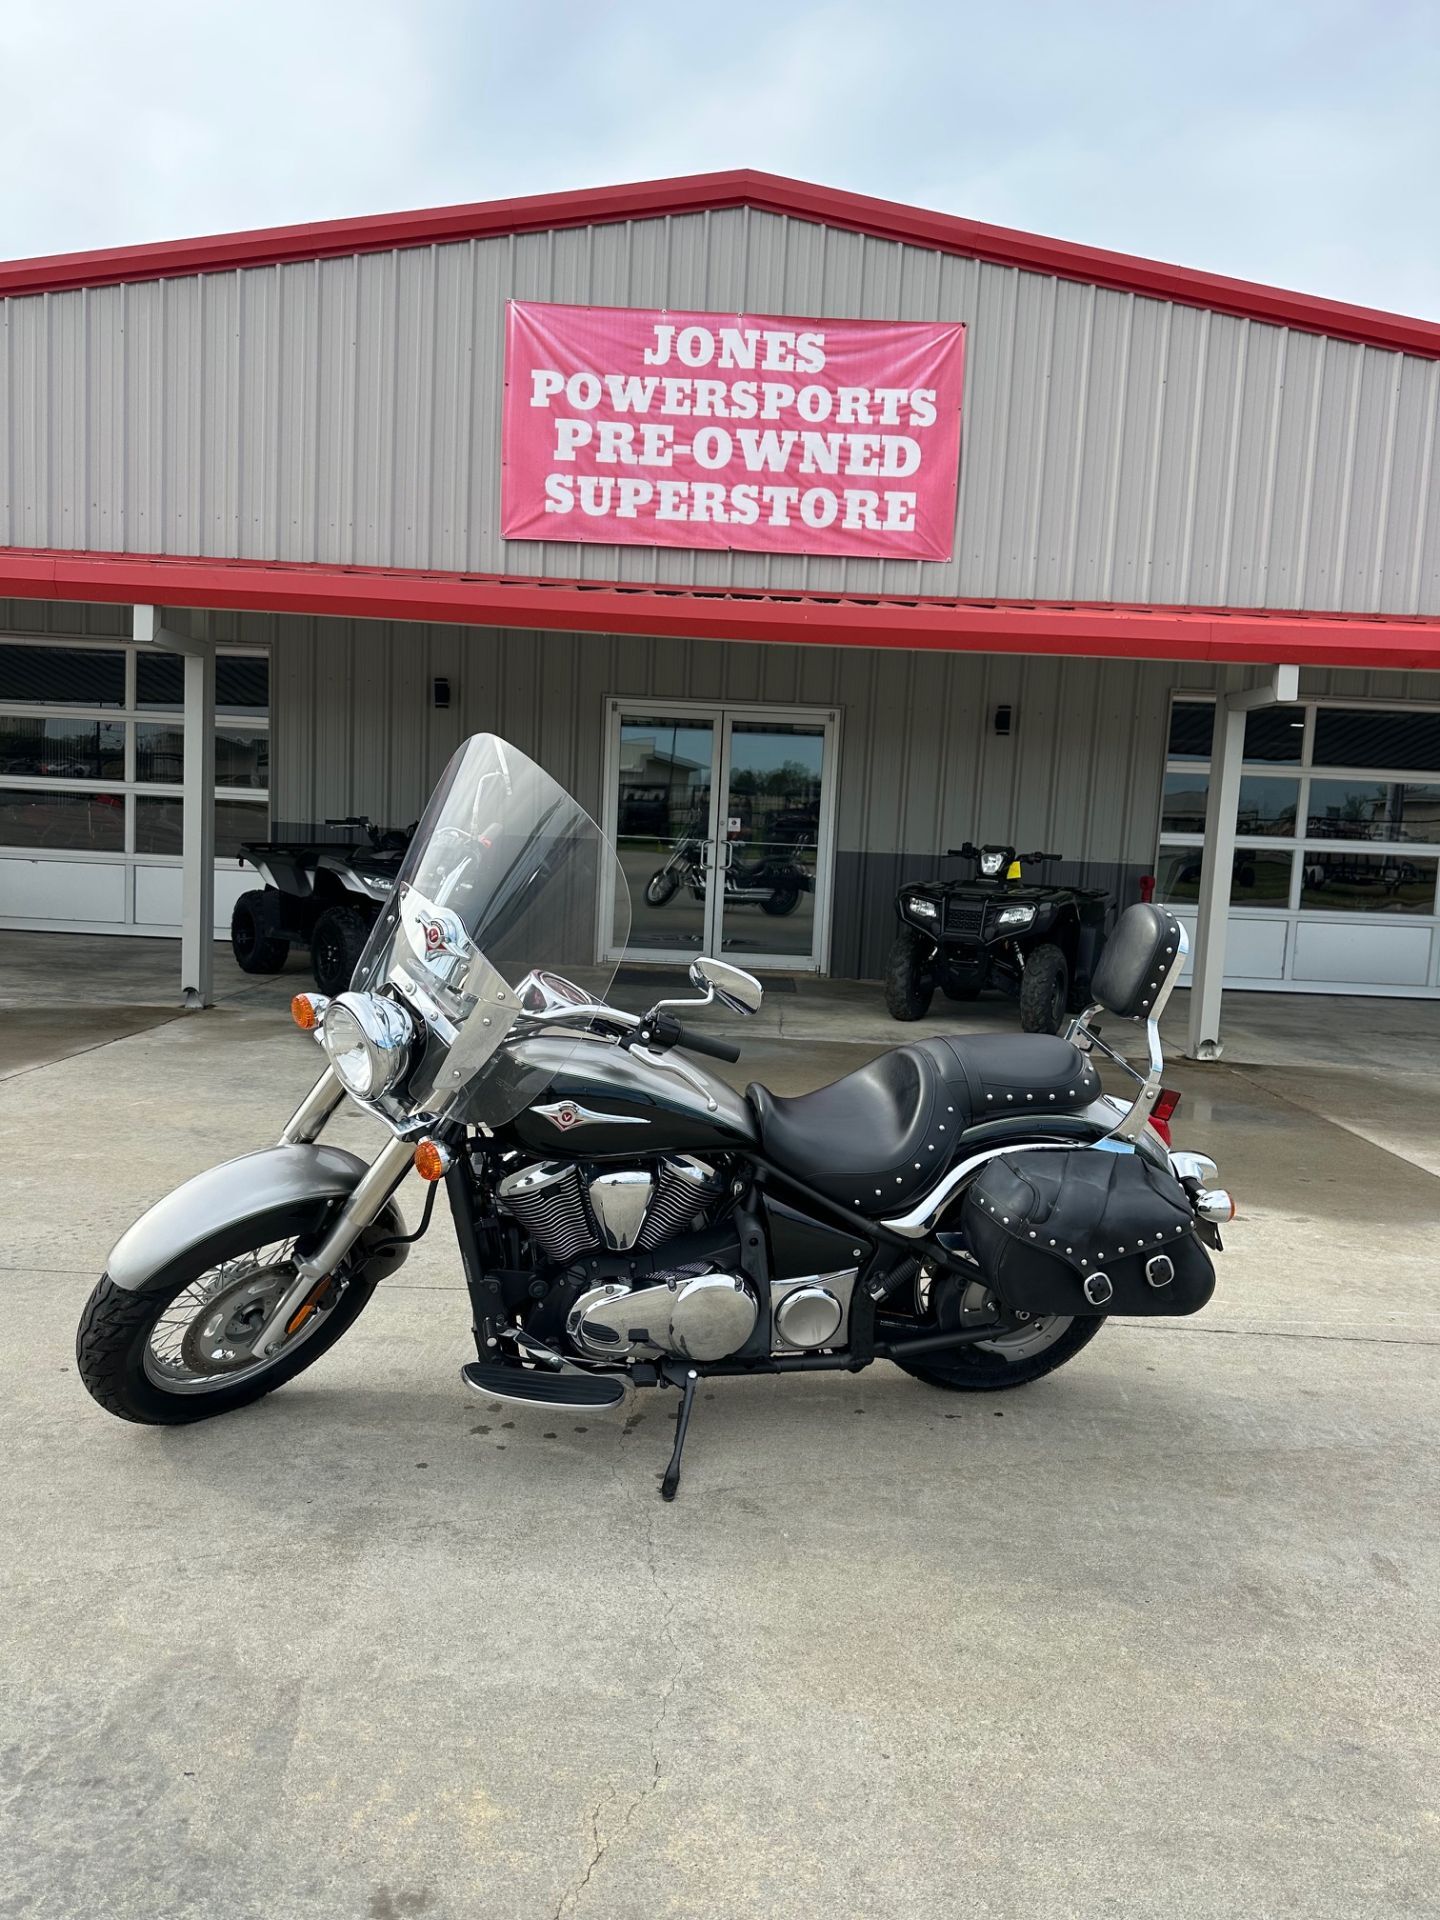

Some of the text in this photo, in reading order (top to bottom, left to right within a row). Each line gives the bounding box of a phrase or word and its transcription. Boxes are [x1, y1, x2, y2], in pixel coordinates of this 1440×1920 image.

[643, 324, 827, 374] JONES
[530, 369, 937, 427] POWERSPORTS
[553, 418, 922, 478] PRE-OWNED
[545, 473, 917, 532] SUPERSTORE
